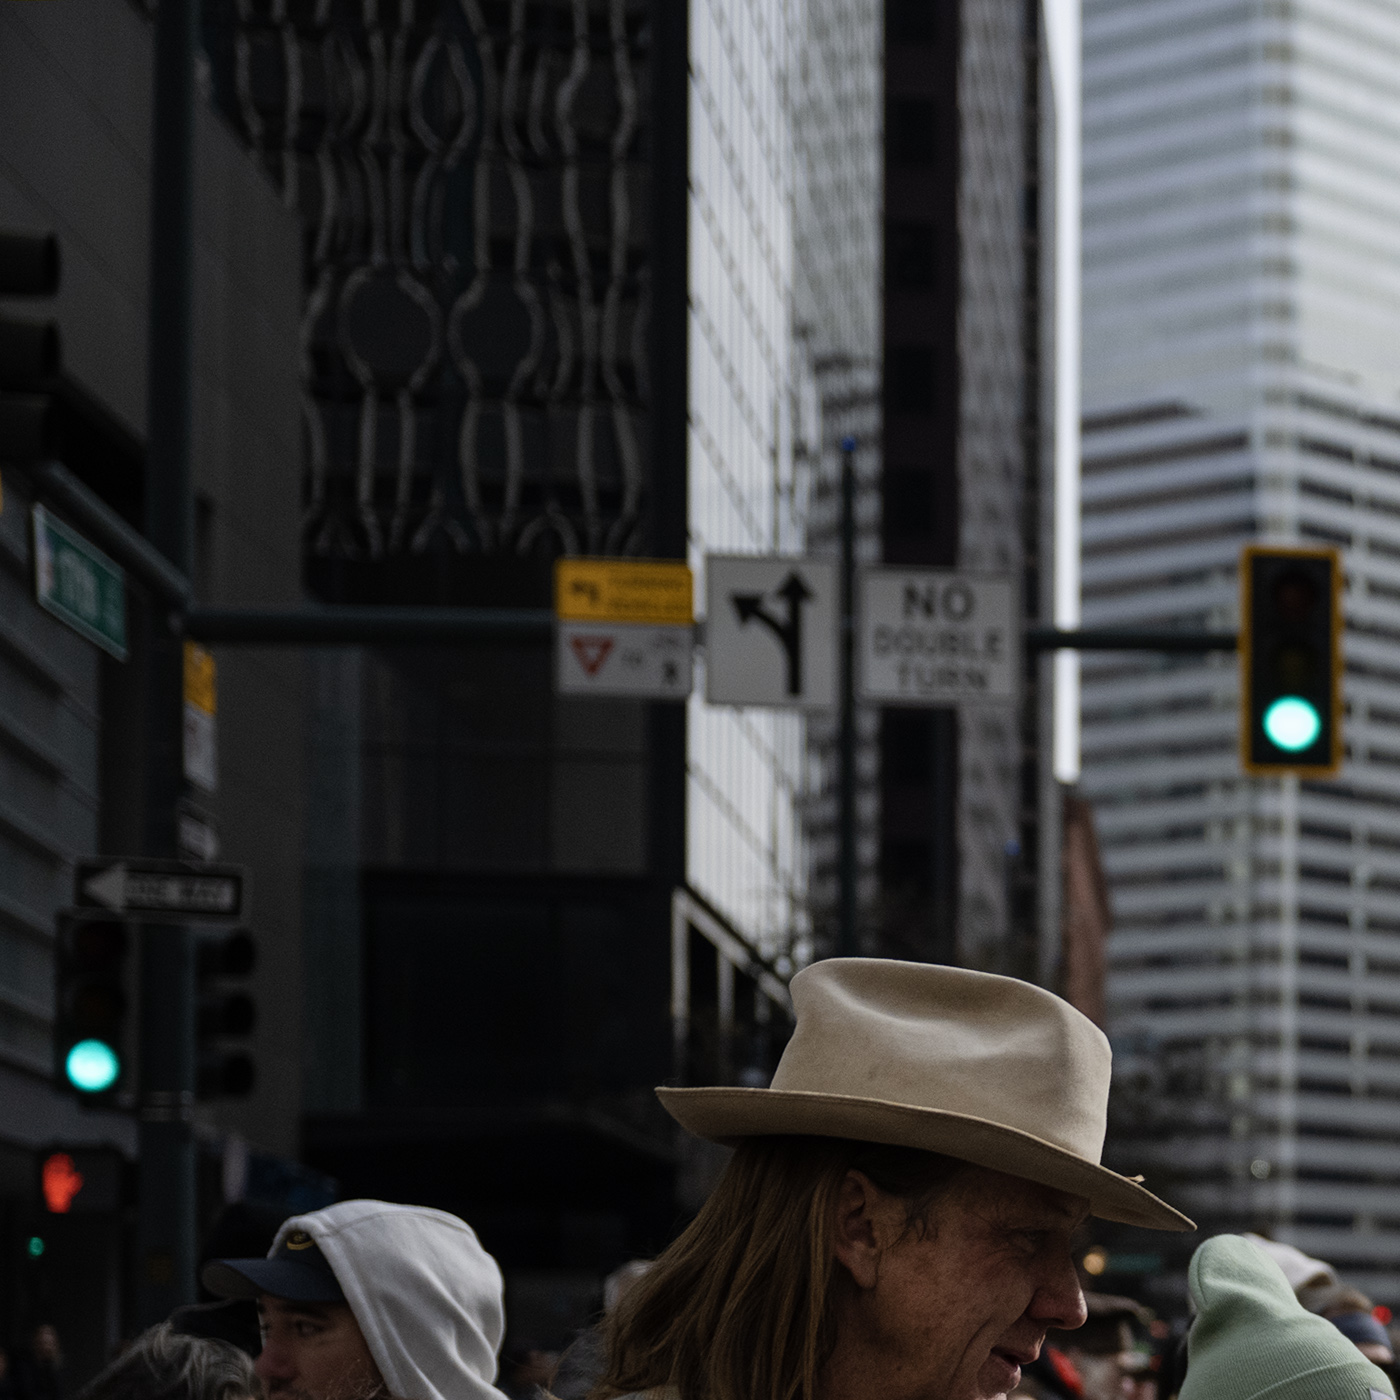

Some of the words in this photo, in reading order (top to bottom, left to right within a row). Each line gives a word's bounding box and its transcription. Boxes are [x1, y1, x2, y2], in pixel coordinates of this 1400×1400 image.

[905, 582, 975, 622] NO
[874, 624, 1004, 662] DOUBLE
[897, 664, 990, 691] TURN
